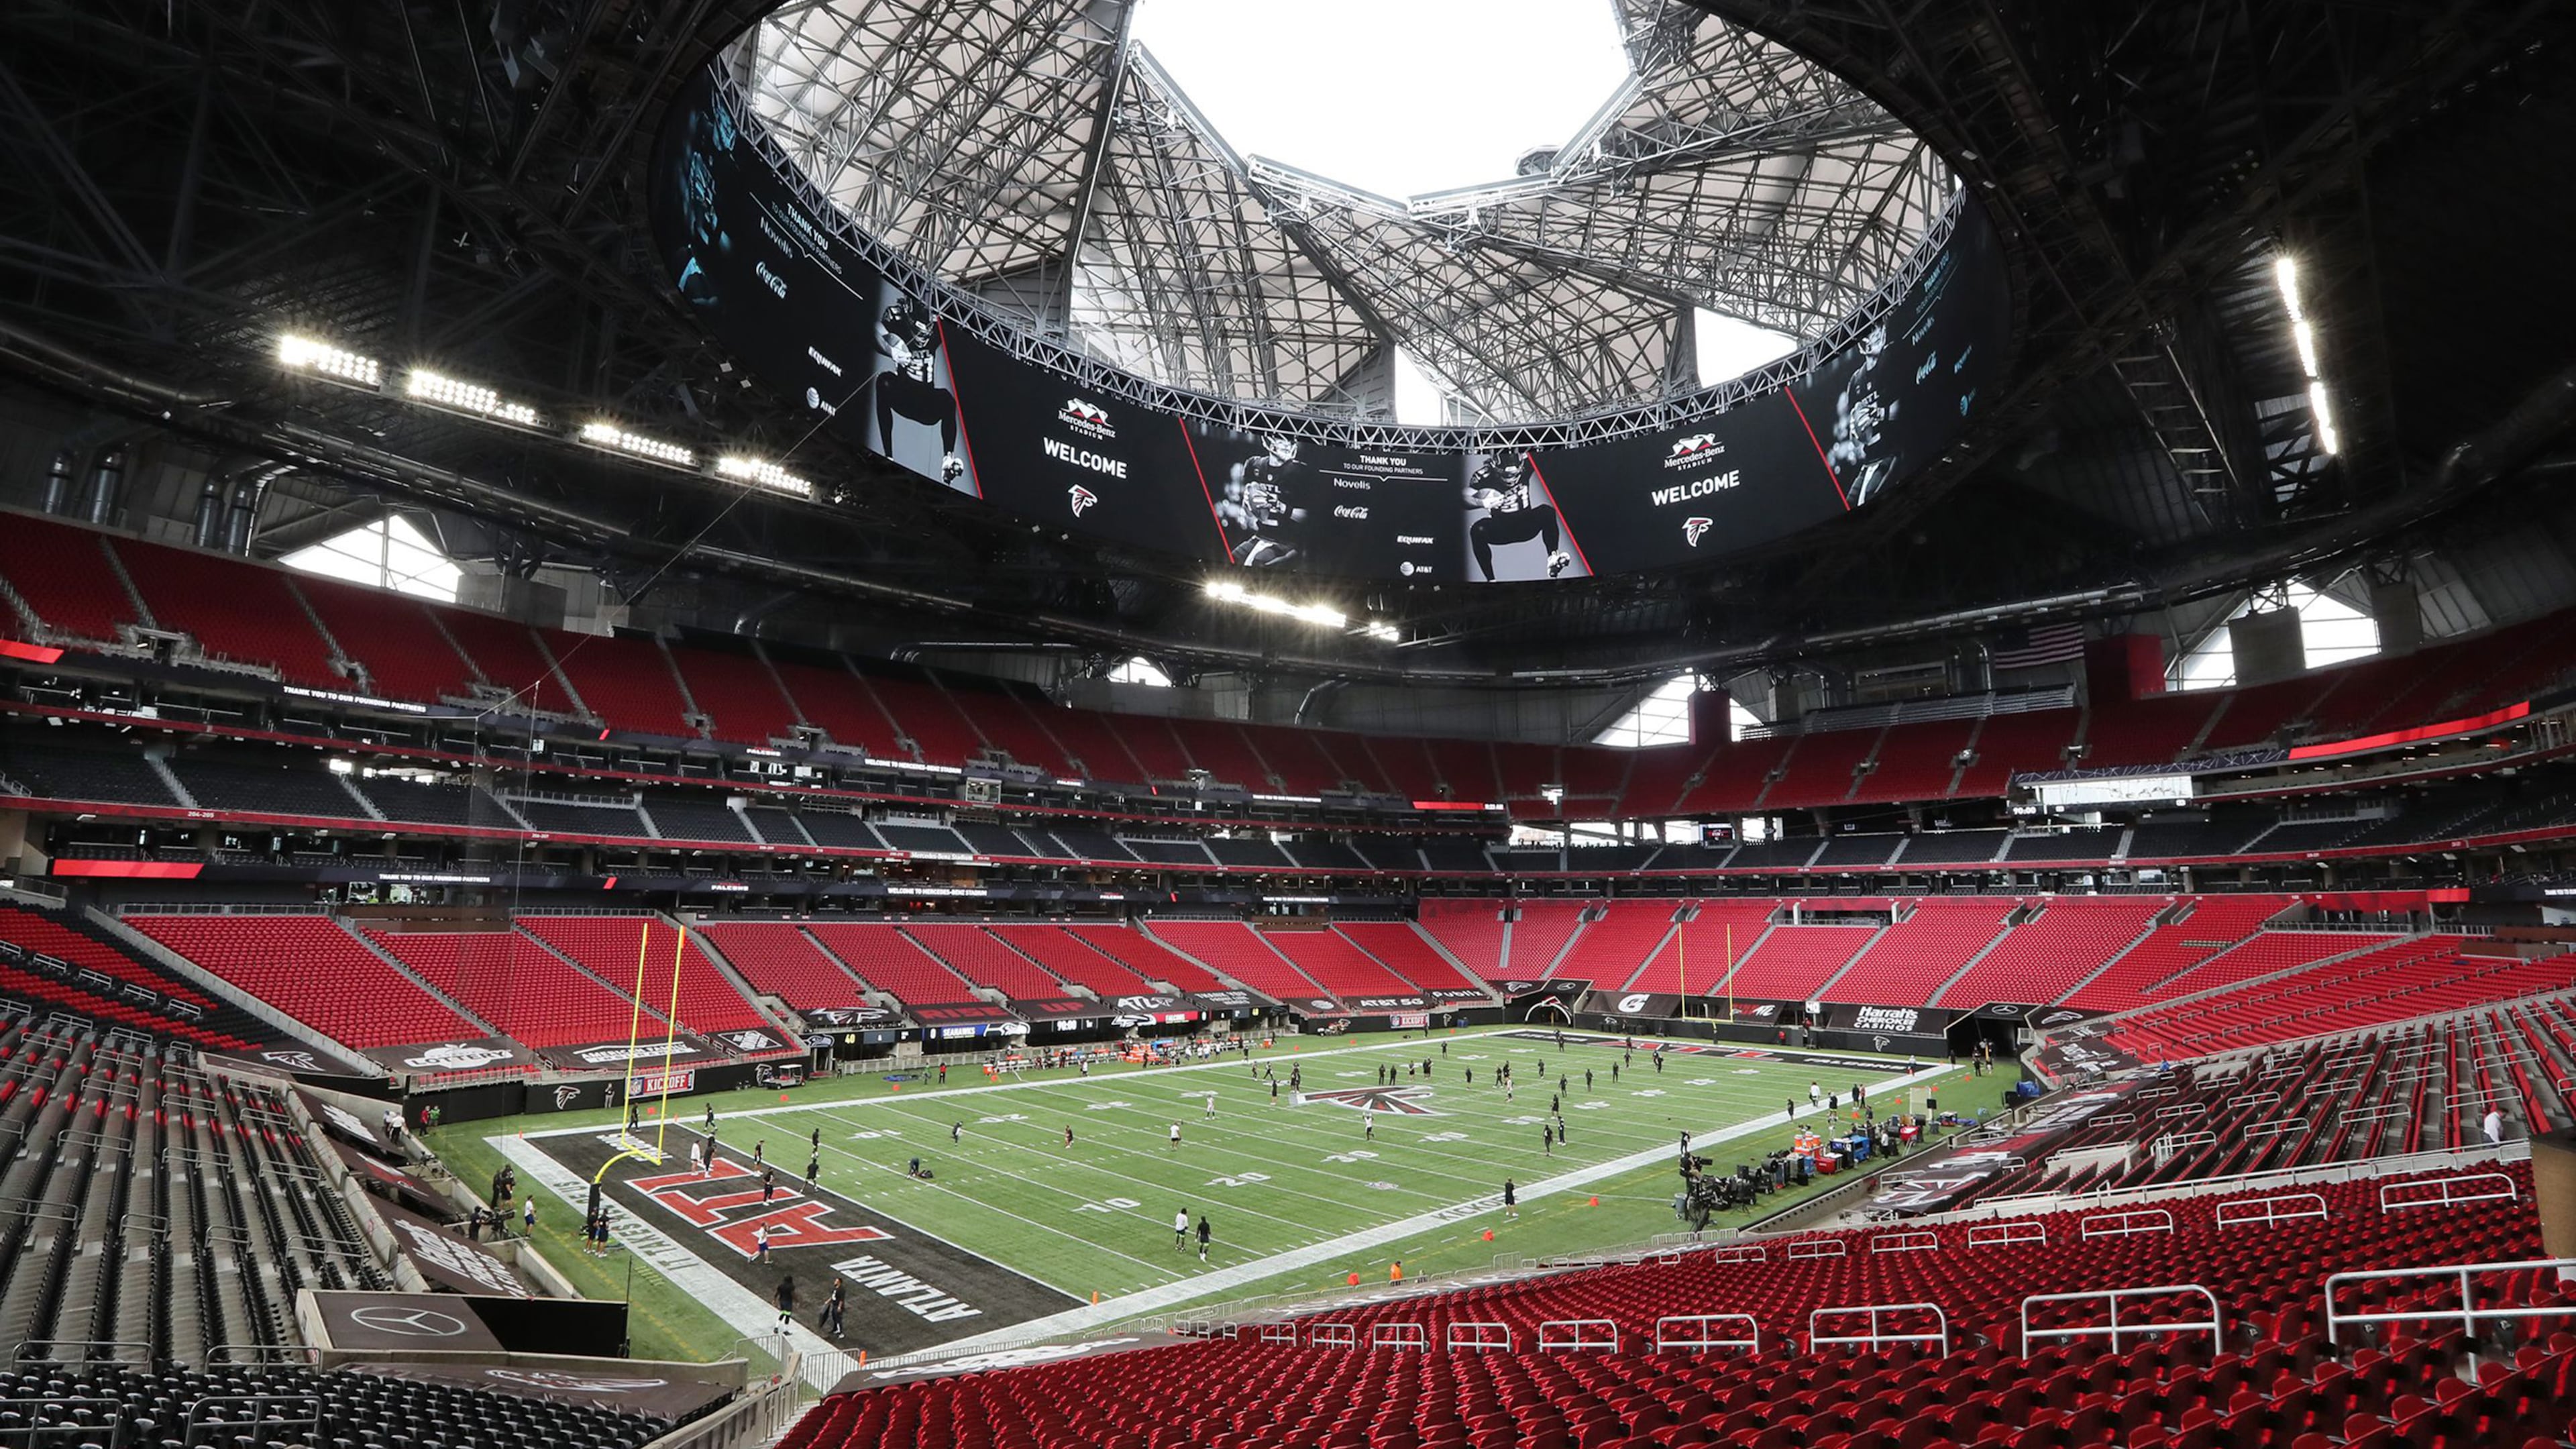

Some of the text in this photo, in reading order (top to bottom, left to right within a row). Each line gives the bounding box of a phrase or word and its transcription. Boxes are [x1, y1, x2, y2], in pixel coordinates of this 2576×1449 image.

[787, 203, 828, 250] THANK YOU
[760, 216, 793, 259] Novelis
[808, 345, 843, 377] EQUIFAX
[820, 400, 837, 417] AT&T
[1058, 410, 1116, 438] Mercedes-Benz
[1070, 425, 1104, 440] STADIUM
[1043, 437, 1128, 479] WELCOME
[1359, 455, 1407, 466] THANK YOU
[1664, 445, 1725, 468] Mercedes-Benz
[1364, 465, 1393, 473] FOUNDING
[1394, 466, 1424, 475] PARTNERS
[1678, 458, 1713, 471] STADIUM
[1333, 478, 1371, 490] Novelis
[1651, 470, 1741, 506] WELCOME
[1396, 535, 1434, 545] EQUIFAX
[1415, 566, 1434, 574] AT&T
[283, 686, 427, 713] THANK YOU TO OUR FOUNDING PARTNERS
[2012, 806, 2036, 815] 90:00
[1432, 989, 1485, 999] Publix
[1038, 1002, 1084, 1012] UP
[1118, 997, 1159, 1011] ATL
[1360, 998, 1424, 1007] AT&T 5G
[915, 1008, 1007, 1020] RISE
[1165, 1014, 1185, 1022] FALCONS
[1858, 1006, 1919, 1020] Harrah's
[1057, 1020, 1077, 1031] 90:00
[1402, 1016, 1427, 1026] KICKOFF
[1854, 1022, 1914, 1032] CASINOS
[1856, 1016, 1917, 1026] CHEROKEE
[943, 1027, 975, 1036] SEAHAWKS
[845, 1034, 856, 1044] 40
[411, 1050, 507, 1065] LOTTERY
[1212, 1173, 1271, 1187] 20
[1081, 1198, 1141, 1212] 10
[830, 1254, 983, 1323] ATLANTA
